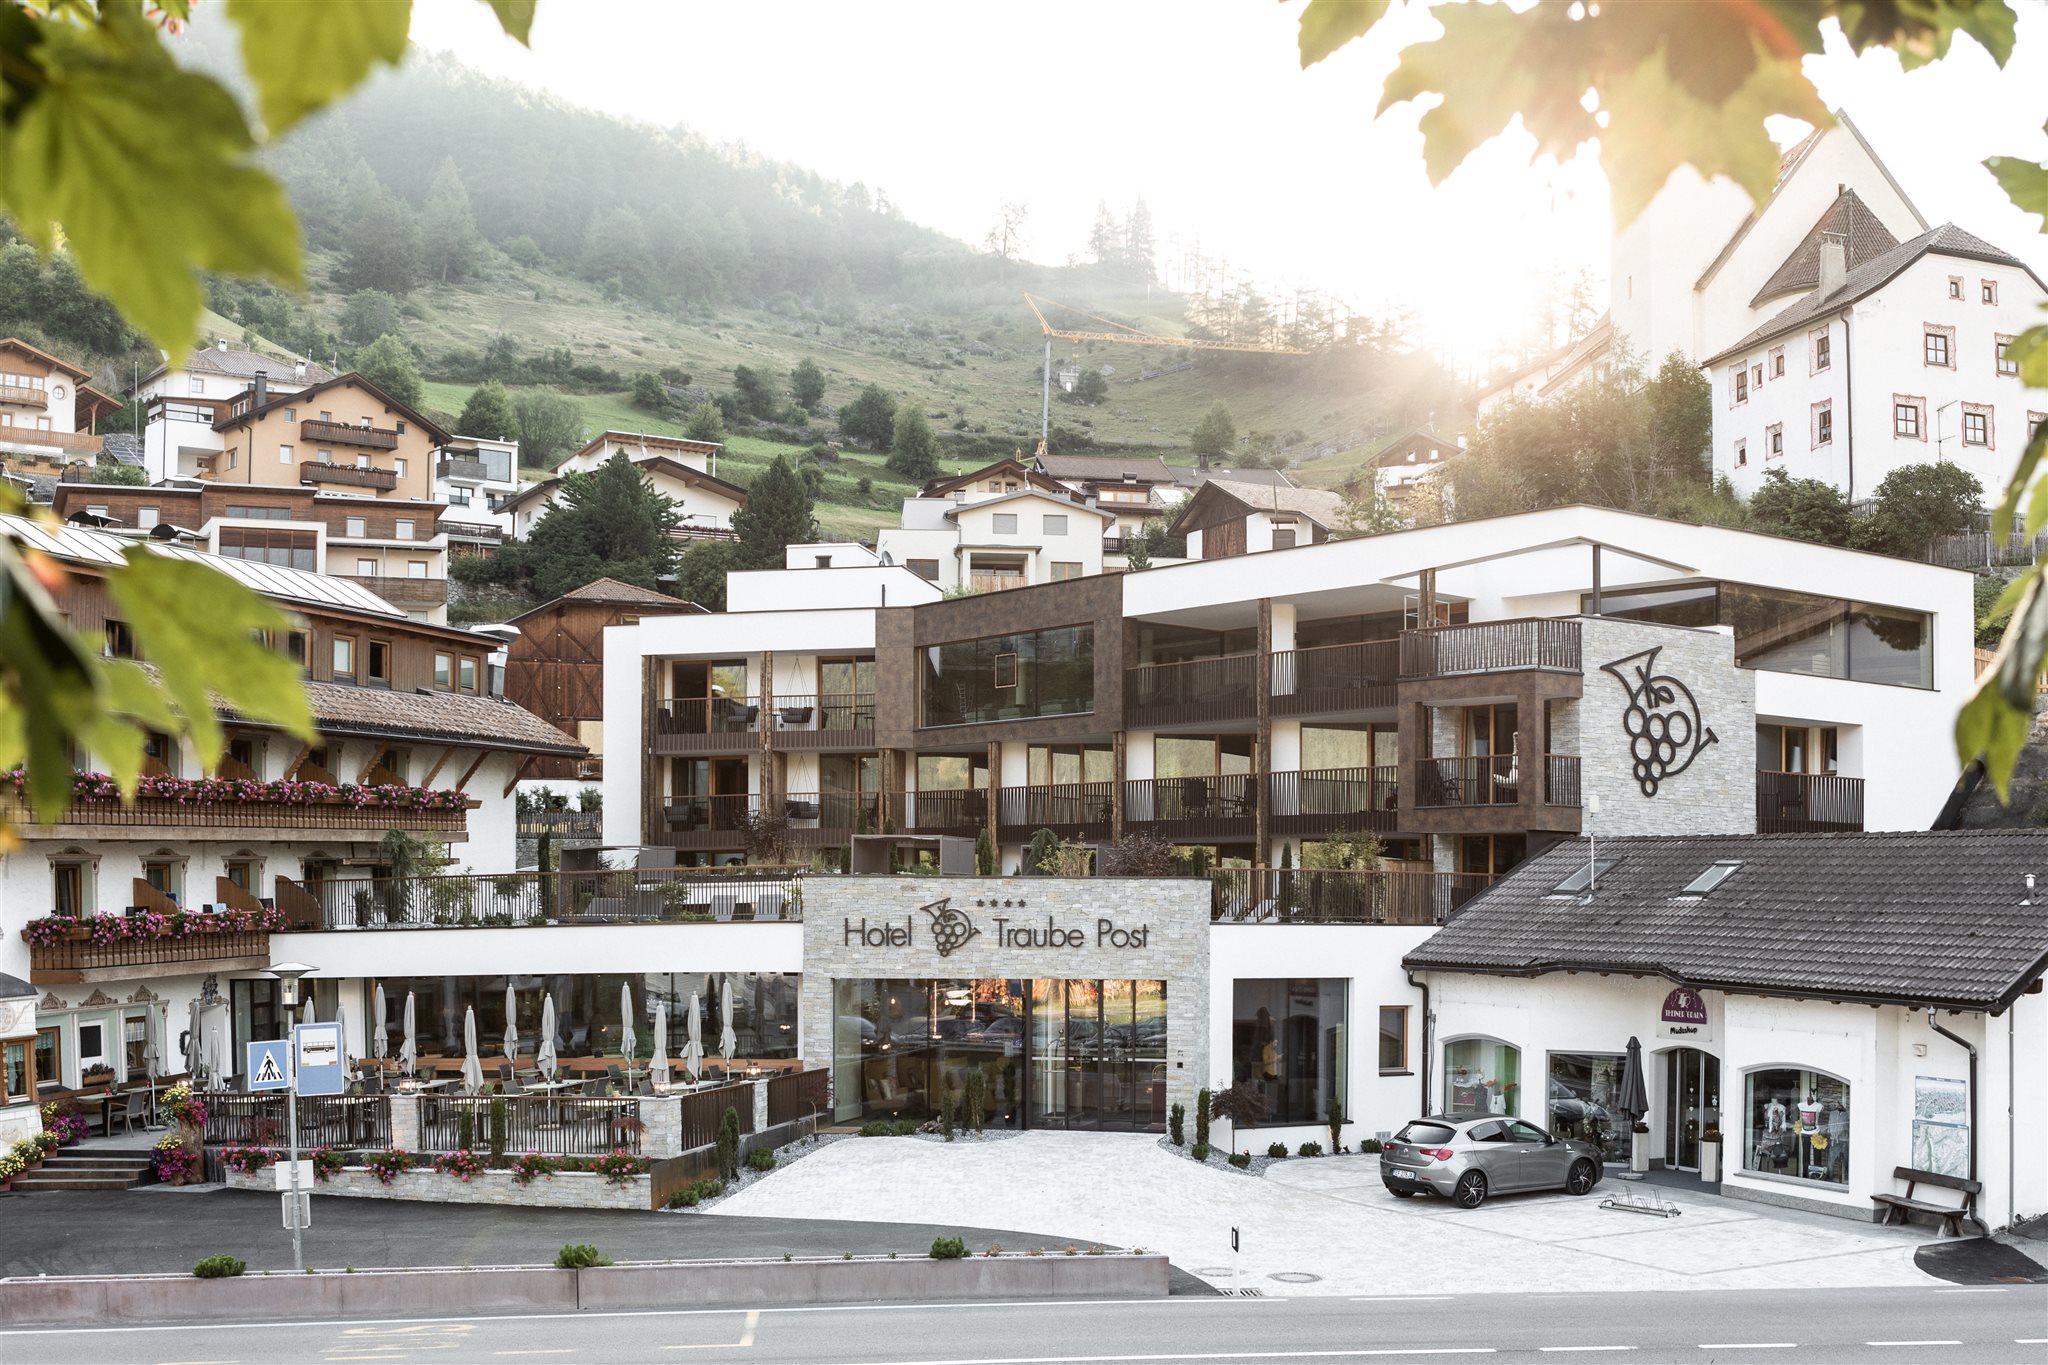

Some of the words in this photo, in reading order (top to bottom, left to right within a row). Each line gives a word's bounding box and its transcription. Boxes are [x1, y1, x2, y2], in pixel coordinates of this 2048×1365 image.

[844, 915, 913, 947] Hotel
[992, 915, 1085, 948] Traube
[1097, 918, 1150, 948] Post
